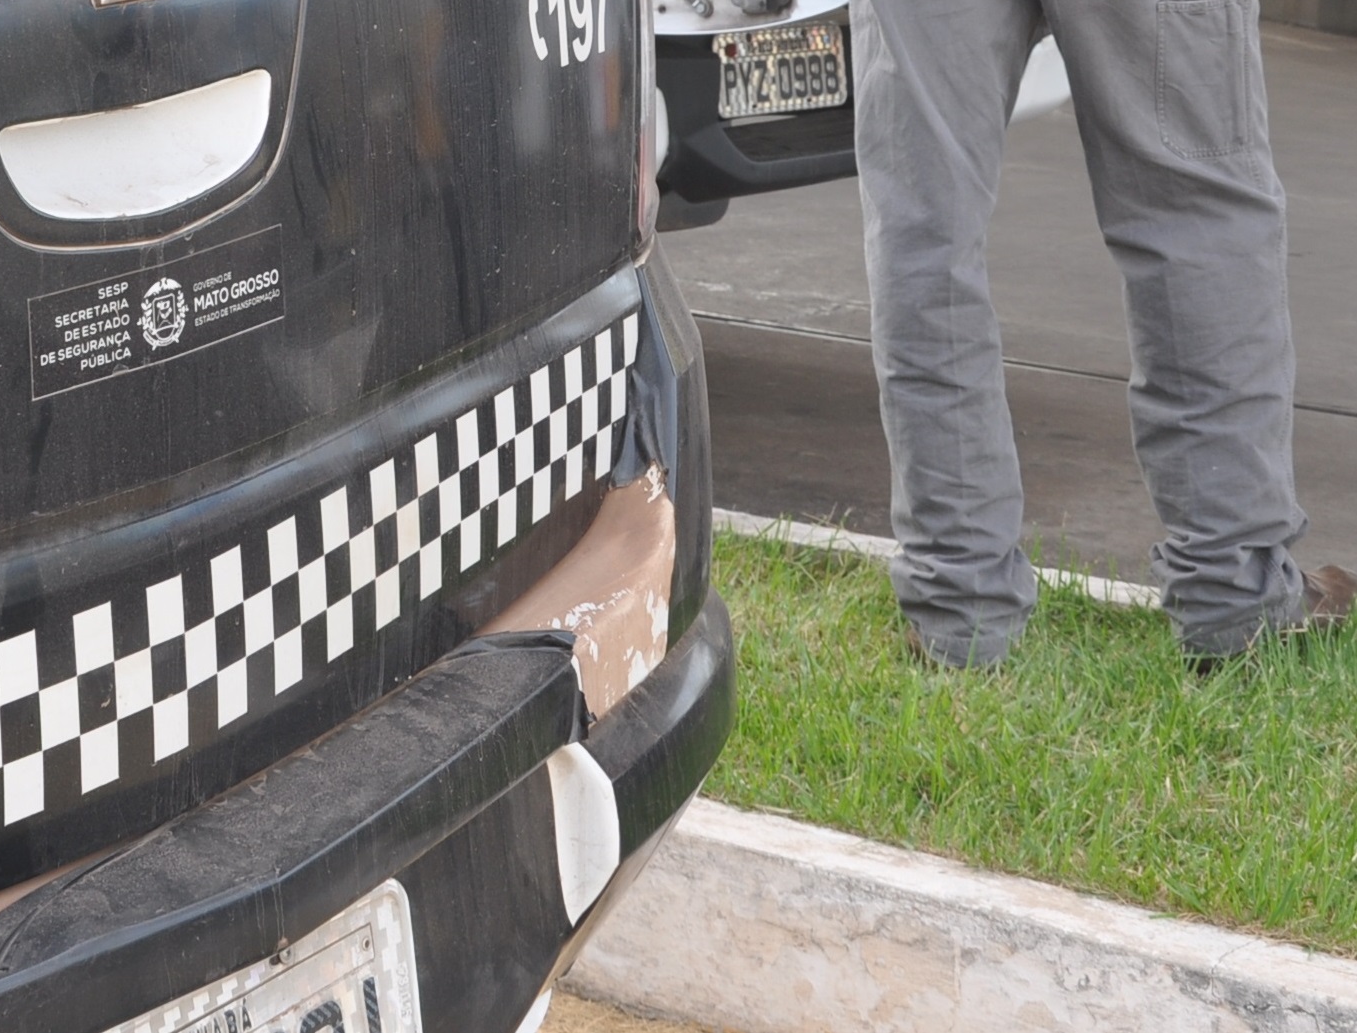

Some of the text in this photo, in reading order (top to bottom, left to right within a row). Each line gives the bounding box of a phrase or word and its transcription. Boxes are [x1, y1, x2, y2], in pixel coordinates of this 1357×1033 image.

[223, 270, 233, 282] DE
[98, 281, 129, 300] SESP
[194, 268, 279, 313] MATO GROSSO
[55, 297, 129, 328] SECRETARIA
[194, 310, 220, 327] ESTADO
[220, 307, 230, 318] DE
[64, 313, 131, 343] DE ESTADO
[40, 330, 132, 367] DE SEGURANÇA
[80, 346, 132, 371] PÚBLICA
